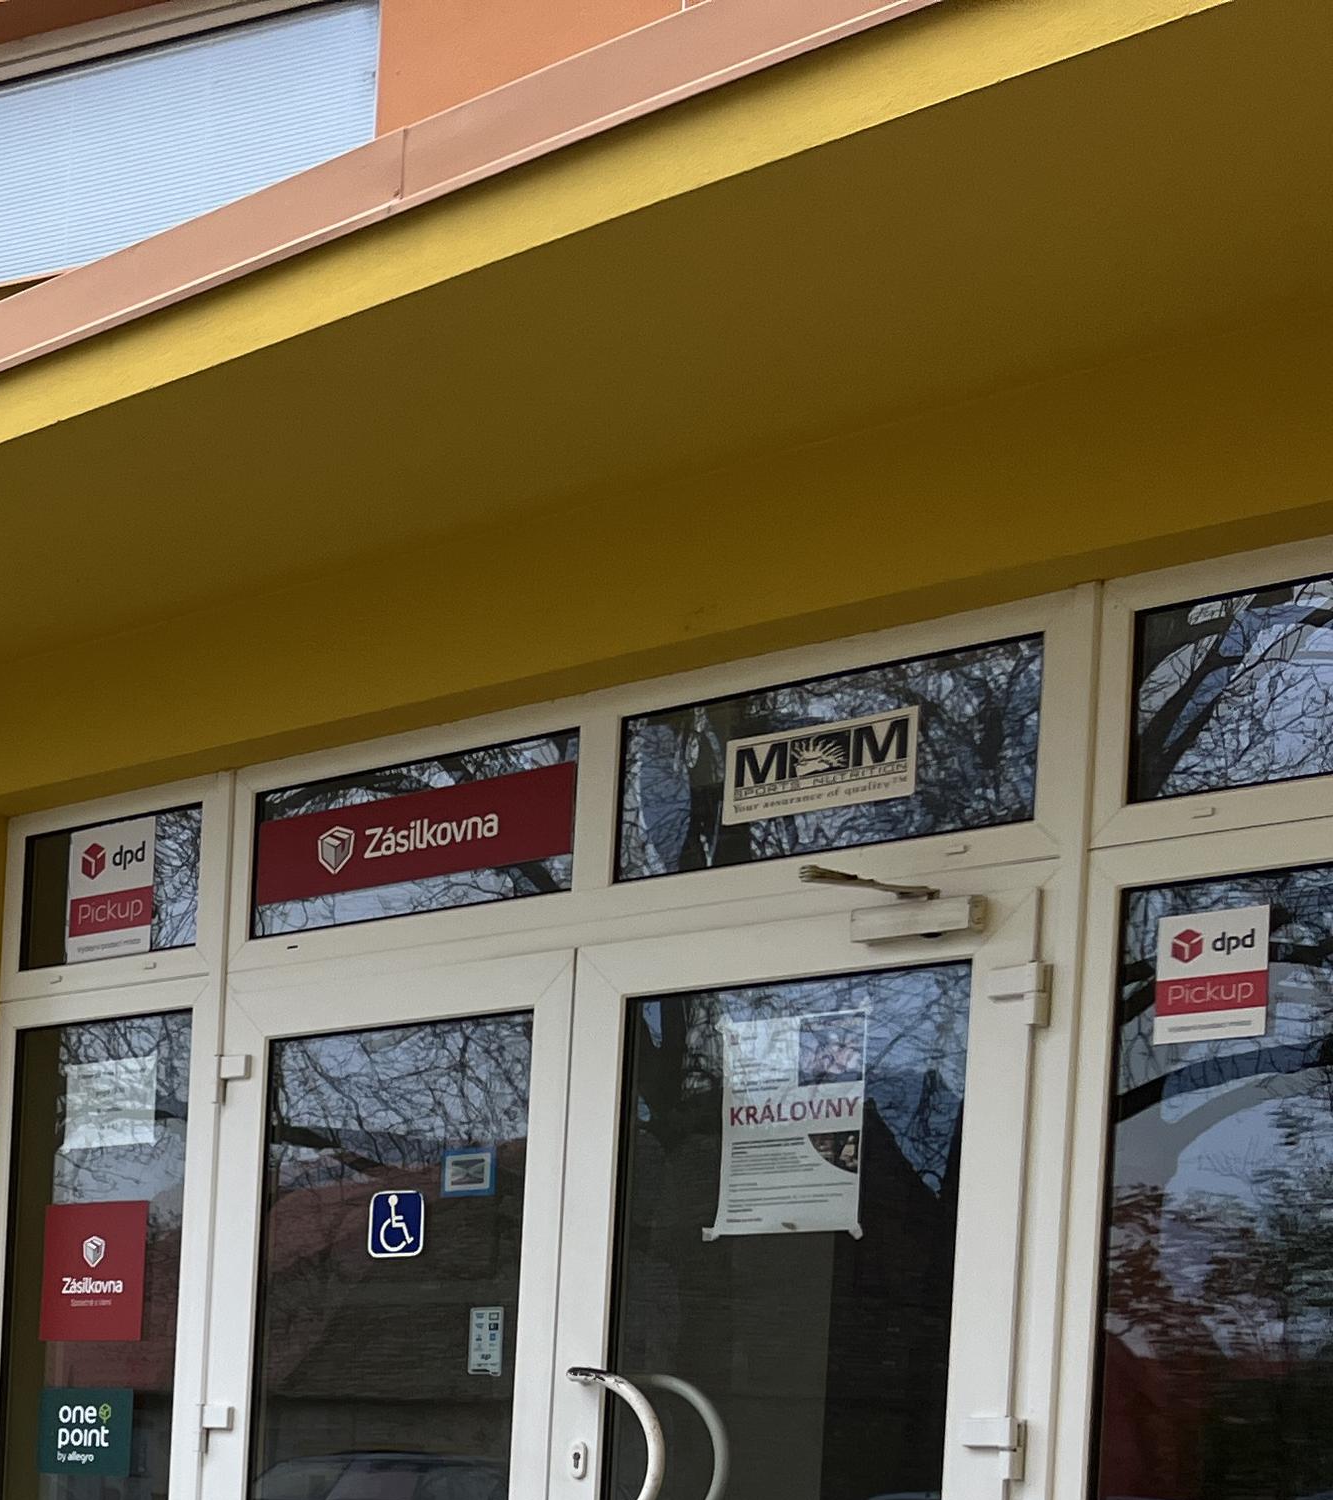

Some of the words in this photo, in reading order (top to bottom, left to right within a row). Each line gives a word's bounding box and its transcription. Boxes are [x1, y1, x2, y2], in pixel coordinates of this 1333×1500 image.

[734, 778, 800, 799] SPORTS
[813, 760, 908, 785] NUTRITION
[733, 803, 758, 814] Your
[826, 789, 839, 798] of
[363, 813, 499, 859] Zásilkovna
[112, 841, 146, 870] dpd
[77, 900, 144, 926] Pickup
[1211, 928, 1256, 955] dpd
[1167, 981, 1255, 1006] Pickup
[729, 1096, 861, 1127] KRÁLOVNY
[61, 1277, 123, 1294] Zásilkovna
[58, 1405, 97, 1424] one
[57, 1426, 110, 1449] point
[56, 1451, 66, 1463] by
[67, 1451, 95, 1465] allegro
